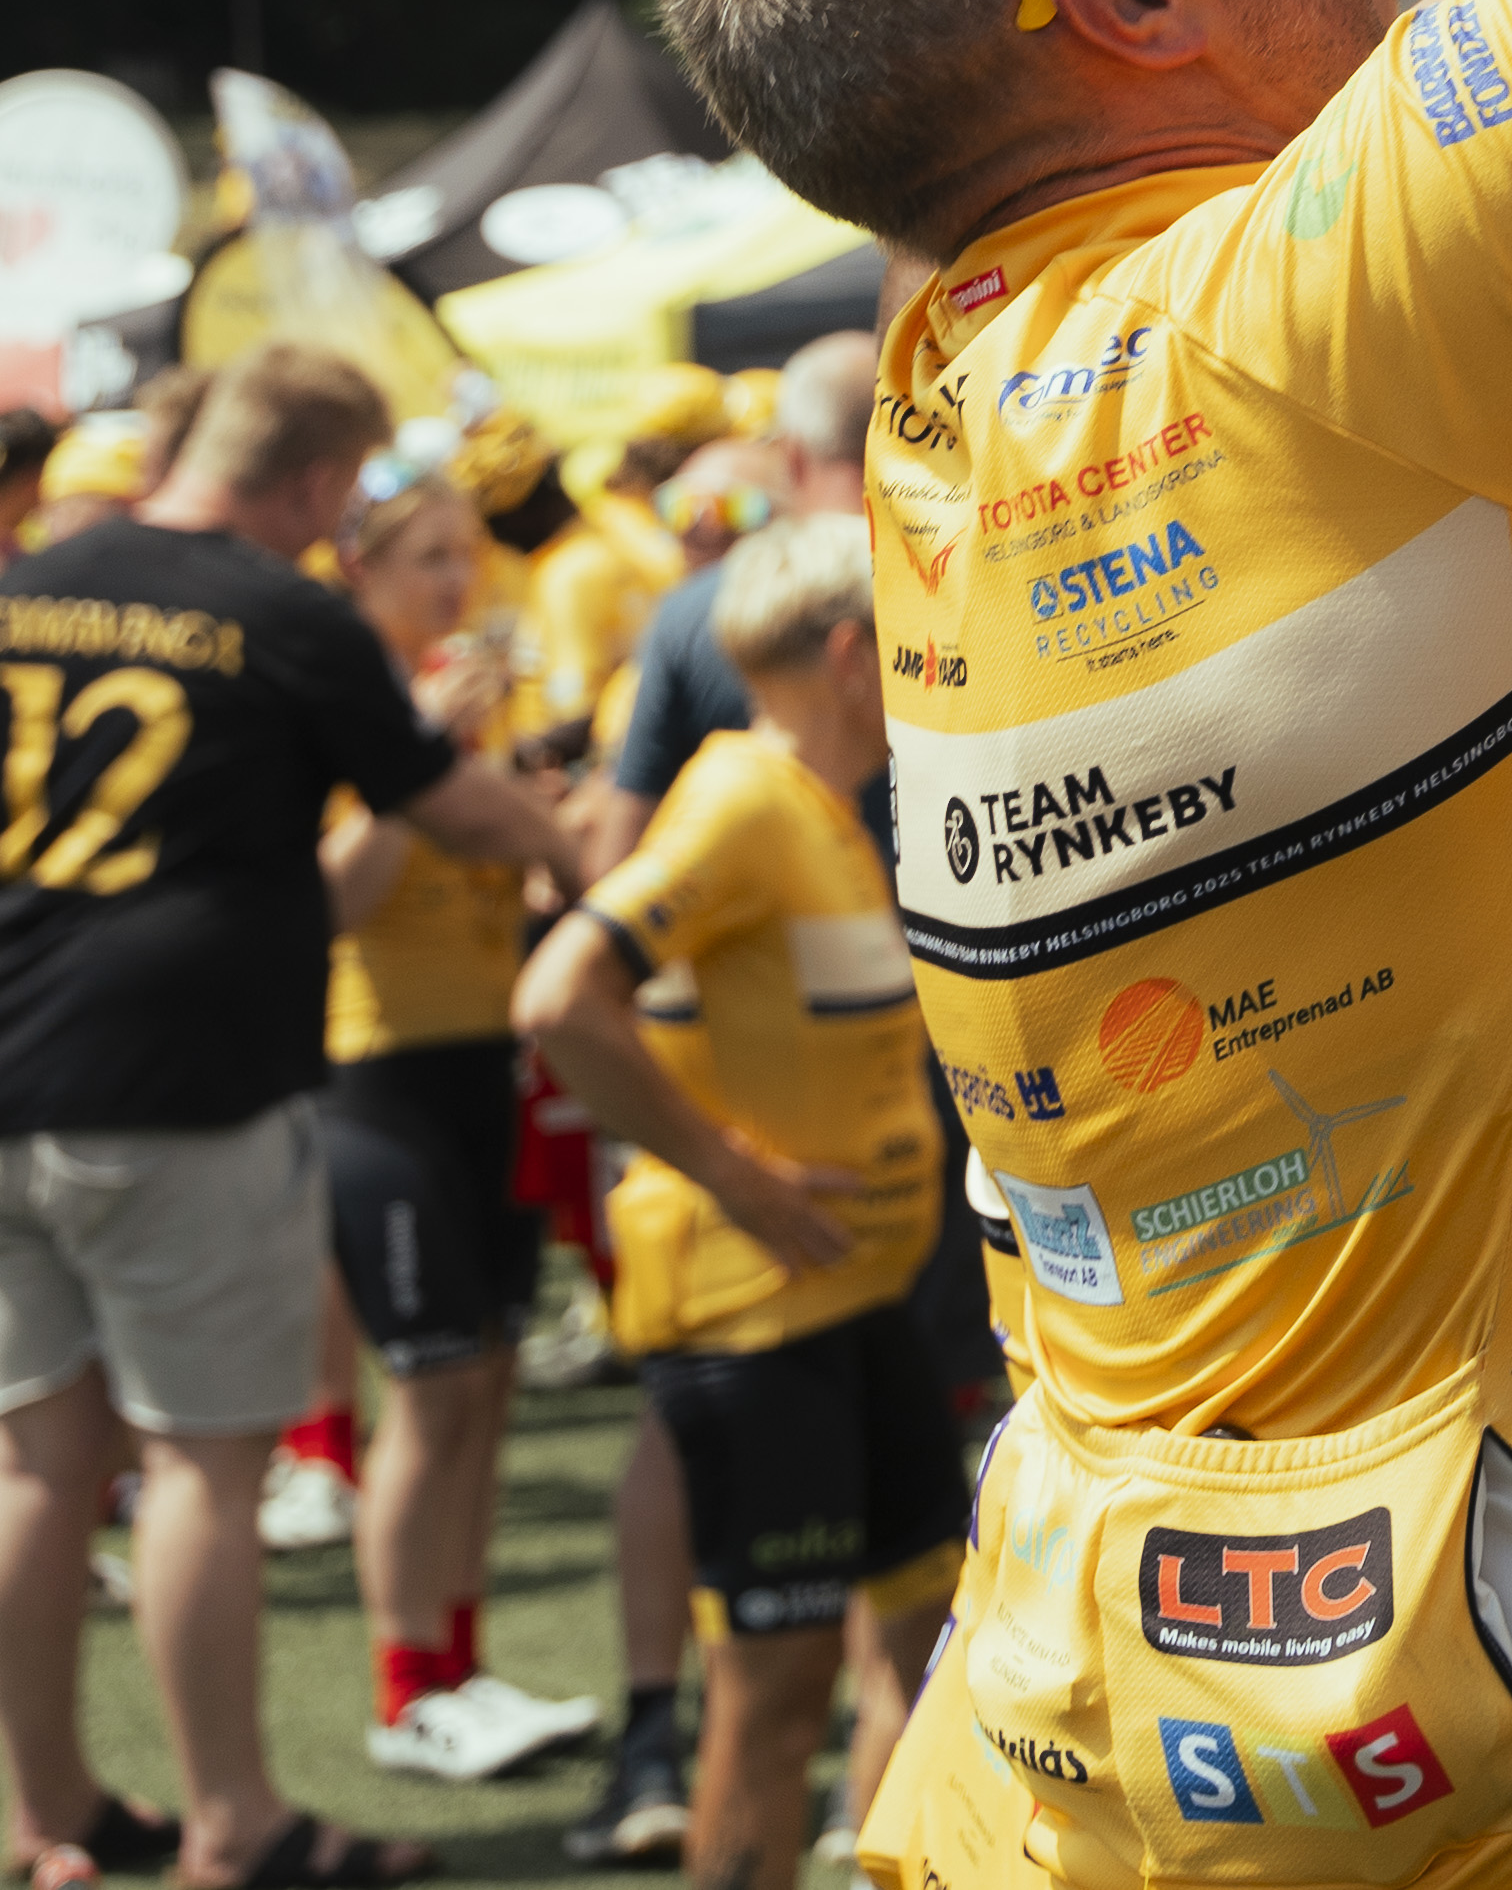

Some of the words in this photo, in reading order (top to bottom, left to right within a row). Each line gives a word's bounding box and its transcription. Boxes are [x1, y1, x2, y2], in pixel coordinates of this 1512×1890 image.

[977, 478, 1071, 536] TOYOTA
[1076, 412, 1213, 497] CENTER
[1059, 518, 1207, 613] STENA
[1035, 565, 1220, 659] RECYCLING
[892, 645, 925, 681] JUMP
[937, 654, 968, 688] YARD
[979, 765, 1117, 837] TEAM
[992, 764, 1238, 885] RYNKEBY
[1046, 891, 1188, 953] HELSINGBORG
[1192, 868, 1243, 899] 2025
[1247, 842, 1304, 876] TEAM
[1310, 790, 1408, 850] RYNKEBY
[1207, 978, 1279, 1032] MAE
[1212, 986, 1354, 1063] Entreprenad
[1360, 967, 1396, 1002] AB
[1136, 1153, 1307, 1238] SCHIERLOH
[1139, 1187, 1317, 1275] ENGINEERING
[1156, 1539, 1378, 1630] LTC
[1158, 1626, 1219, 1653] Makes
[1221, 1630, 1281, 1658] mobile
[1284, 1633, 1334, 1659] living
[1335, 1617, 1378, 1649] easy
[1176, 1729, 1425, 1816] STS
